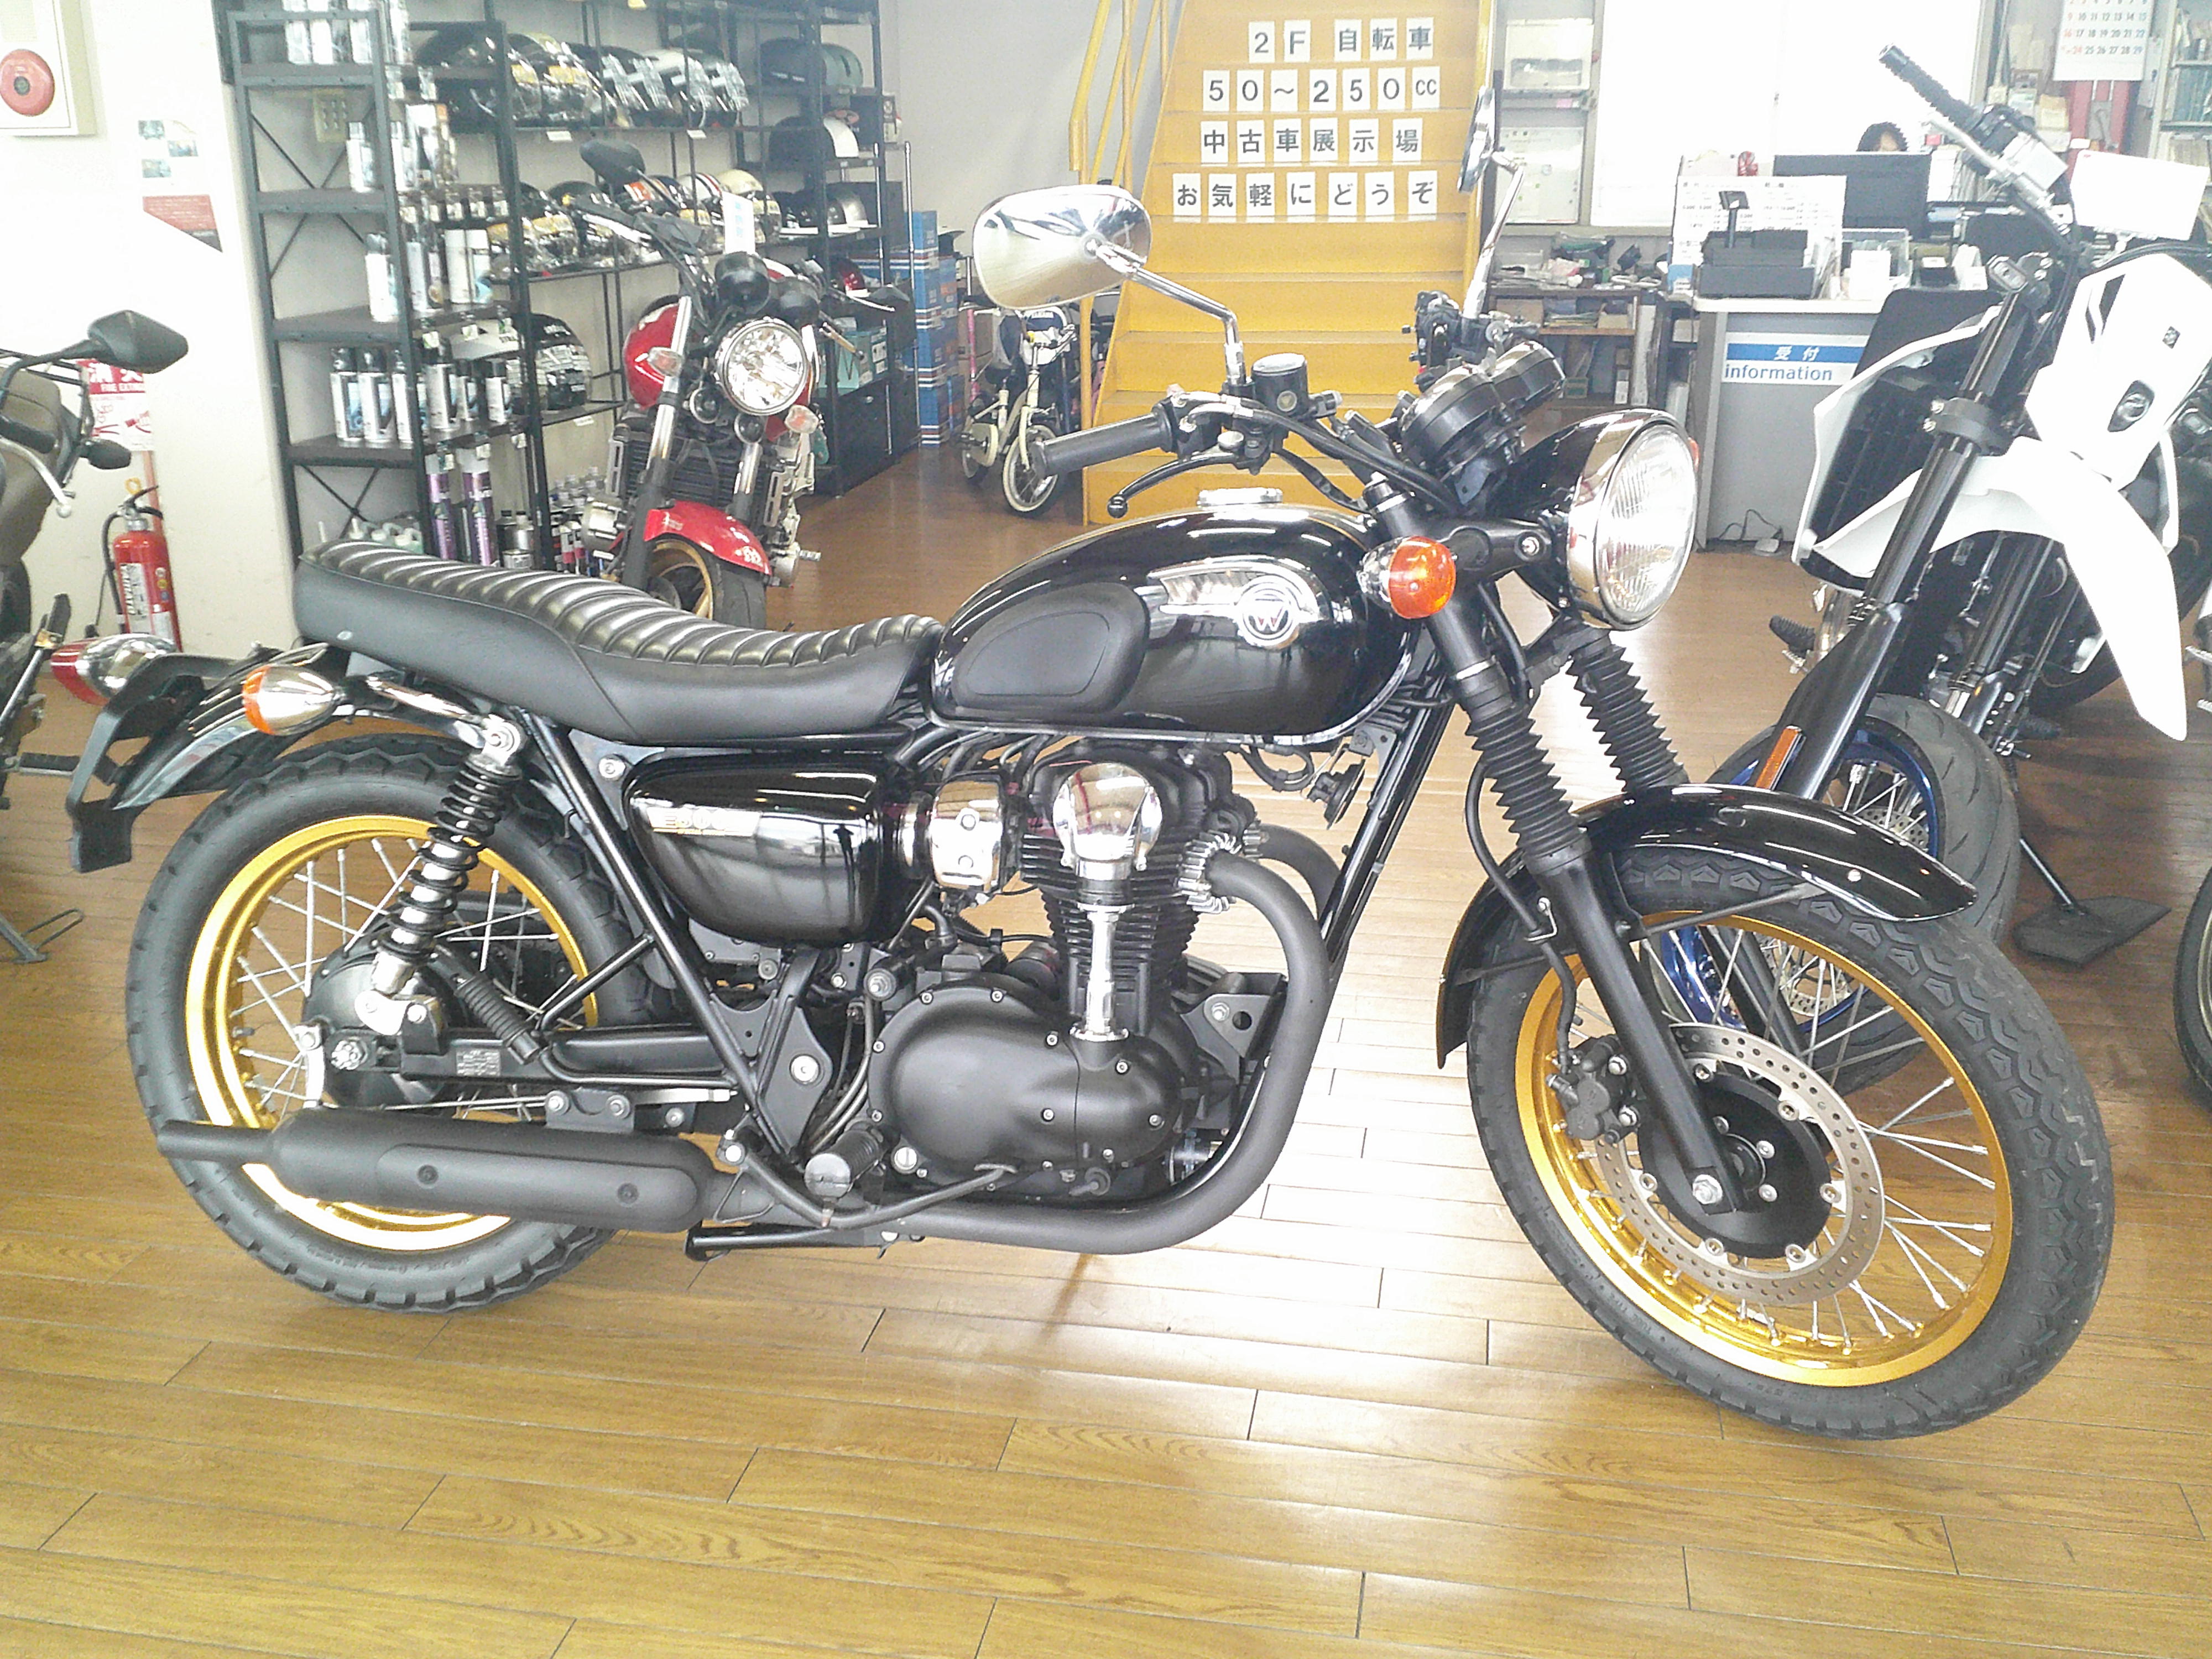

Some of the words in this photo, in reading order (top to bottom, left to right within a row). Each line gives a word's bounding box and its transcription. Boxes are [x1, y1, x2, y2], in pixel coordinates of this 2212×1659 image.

[1254, 30, 1306, 55] 2F
[1339, 27, 1433, 53] 自転車
[1204, 128, 1419, 154] 中古車展示場
[1178, 181, 1434, 207] お気軽にどうぞ
[1773, 346, 1819, 361] 受付
[1725, 364, 1832, 381] information
[1248, 604, 1288, 632] W
